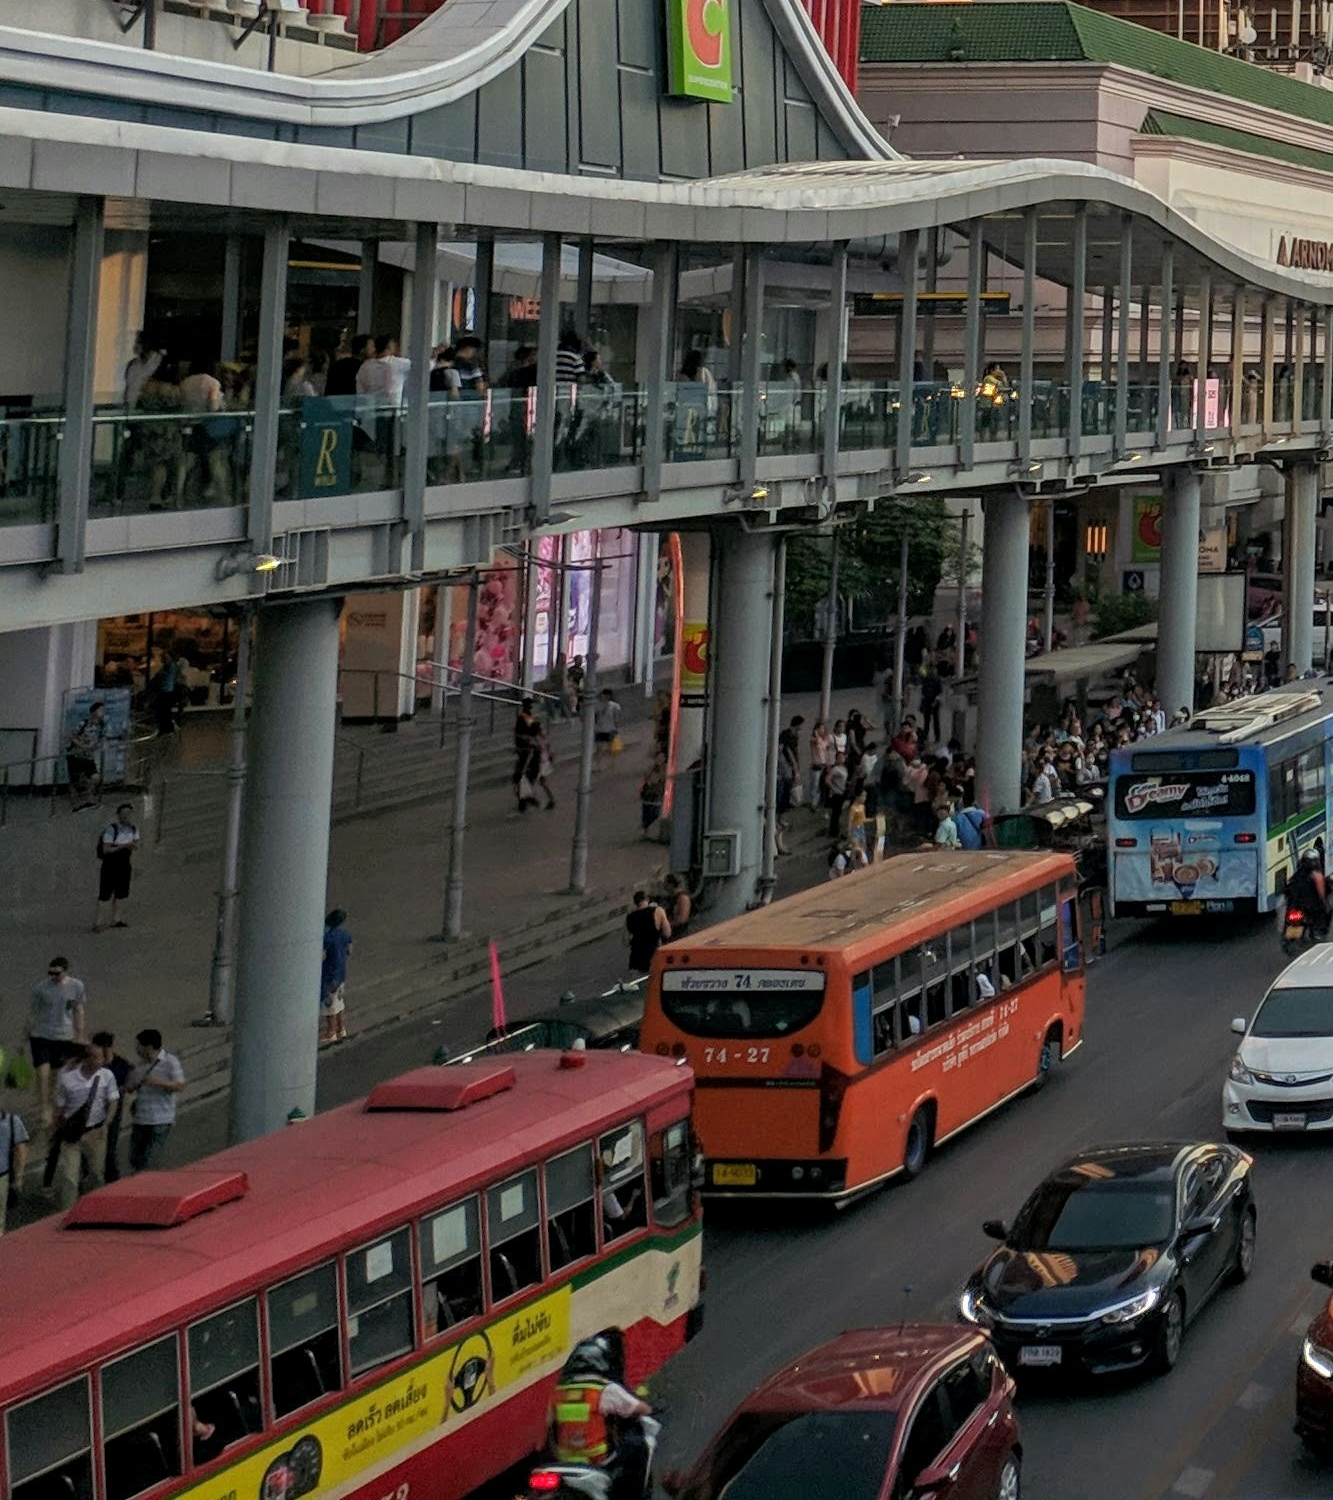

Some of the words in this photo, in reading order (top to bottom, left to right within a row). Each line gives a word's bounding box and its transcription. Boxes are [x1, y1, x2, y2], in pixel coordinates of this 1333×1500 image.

[1199, 545, 1220, 555] OMA
[1126, 783, 1191, 812] Dreamy
[734, 974, 752, 989] 74
